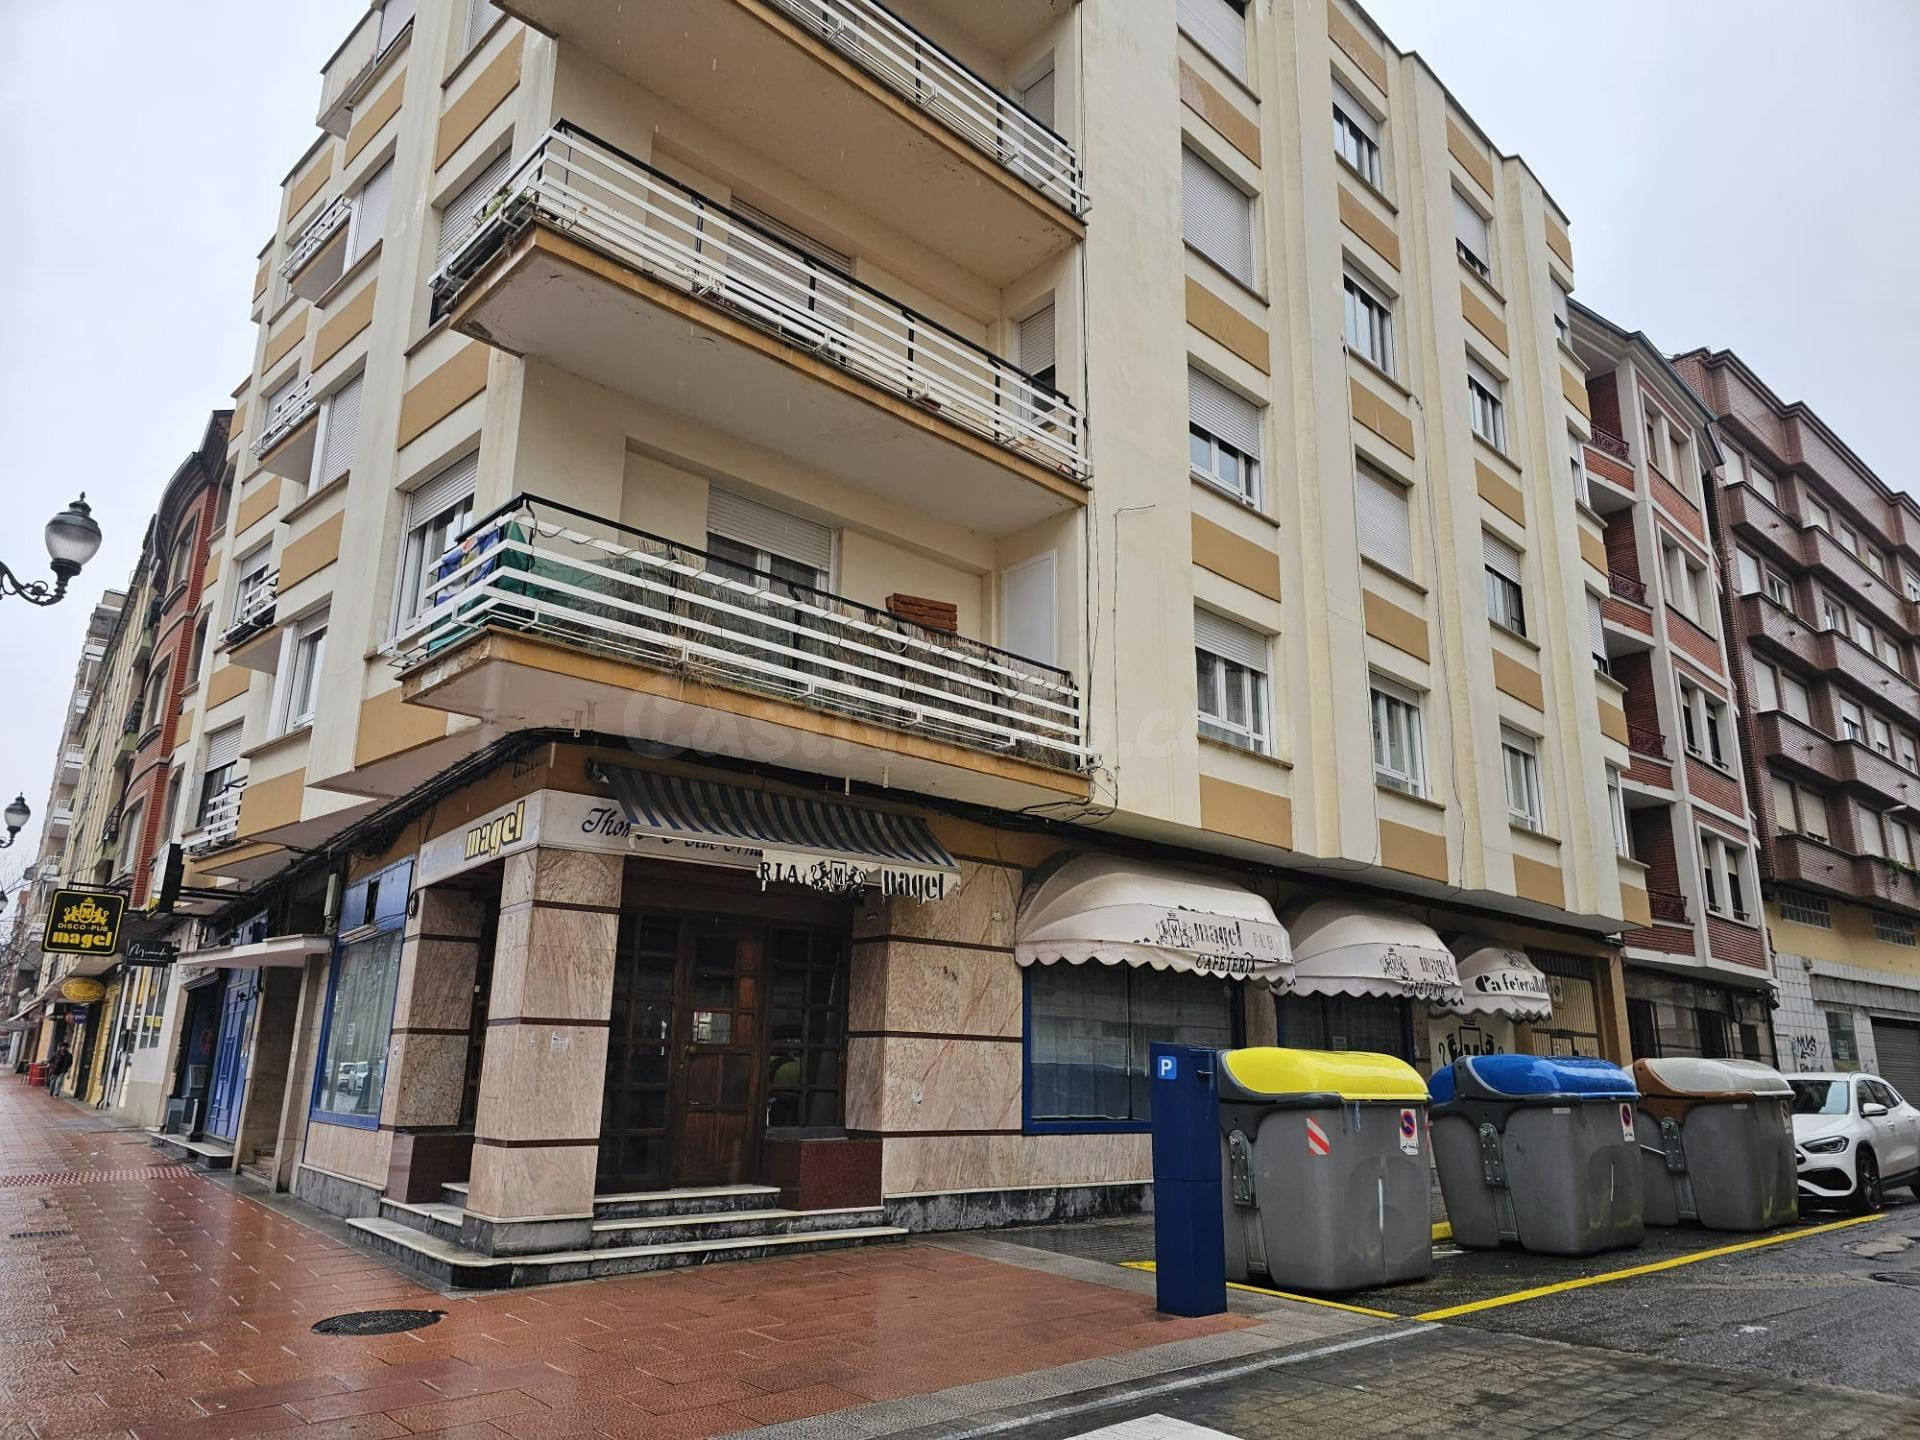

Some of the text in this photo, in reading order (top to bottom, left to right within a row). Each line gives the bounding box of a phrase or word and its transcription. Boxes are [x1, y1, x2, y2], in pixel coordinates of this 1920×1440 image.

[57, 922, 109, 932] DISCO PUB
[51, 931, 113, 948] magel
[1160, 1059, 1172, 1076] P
